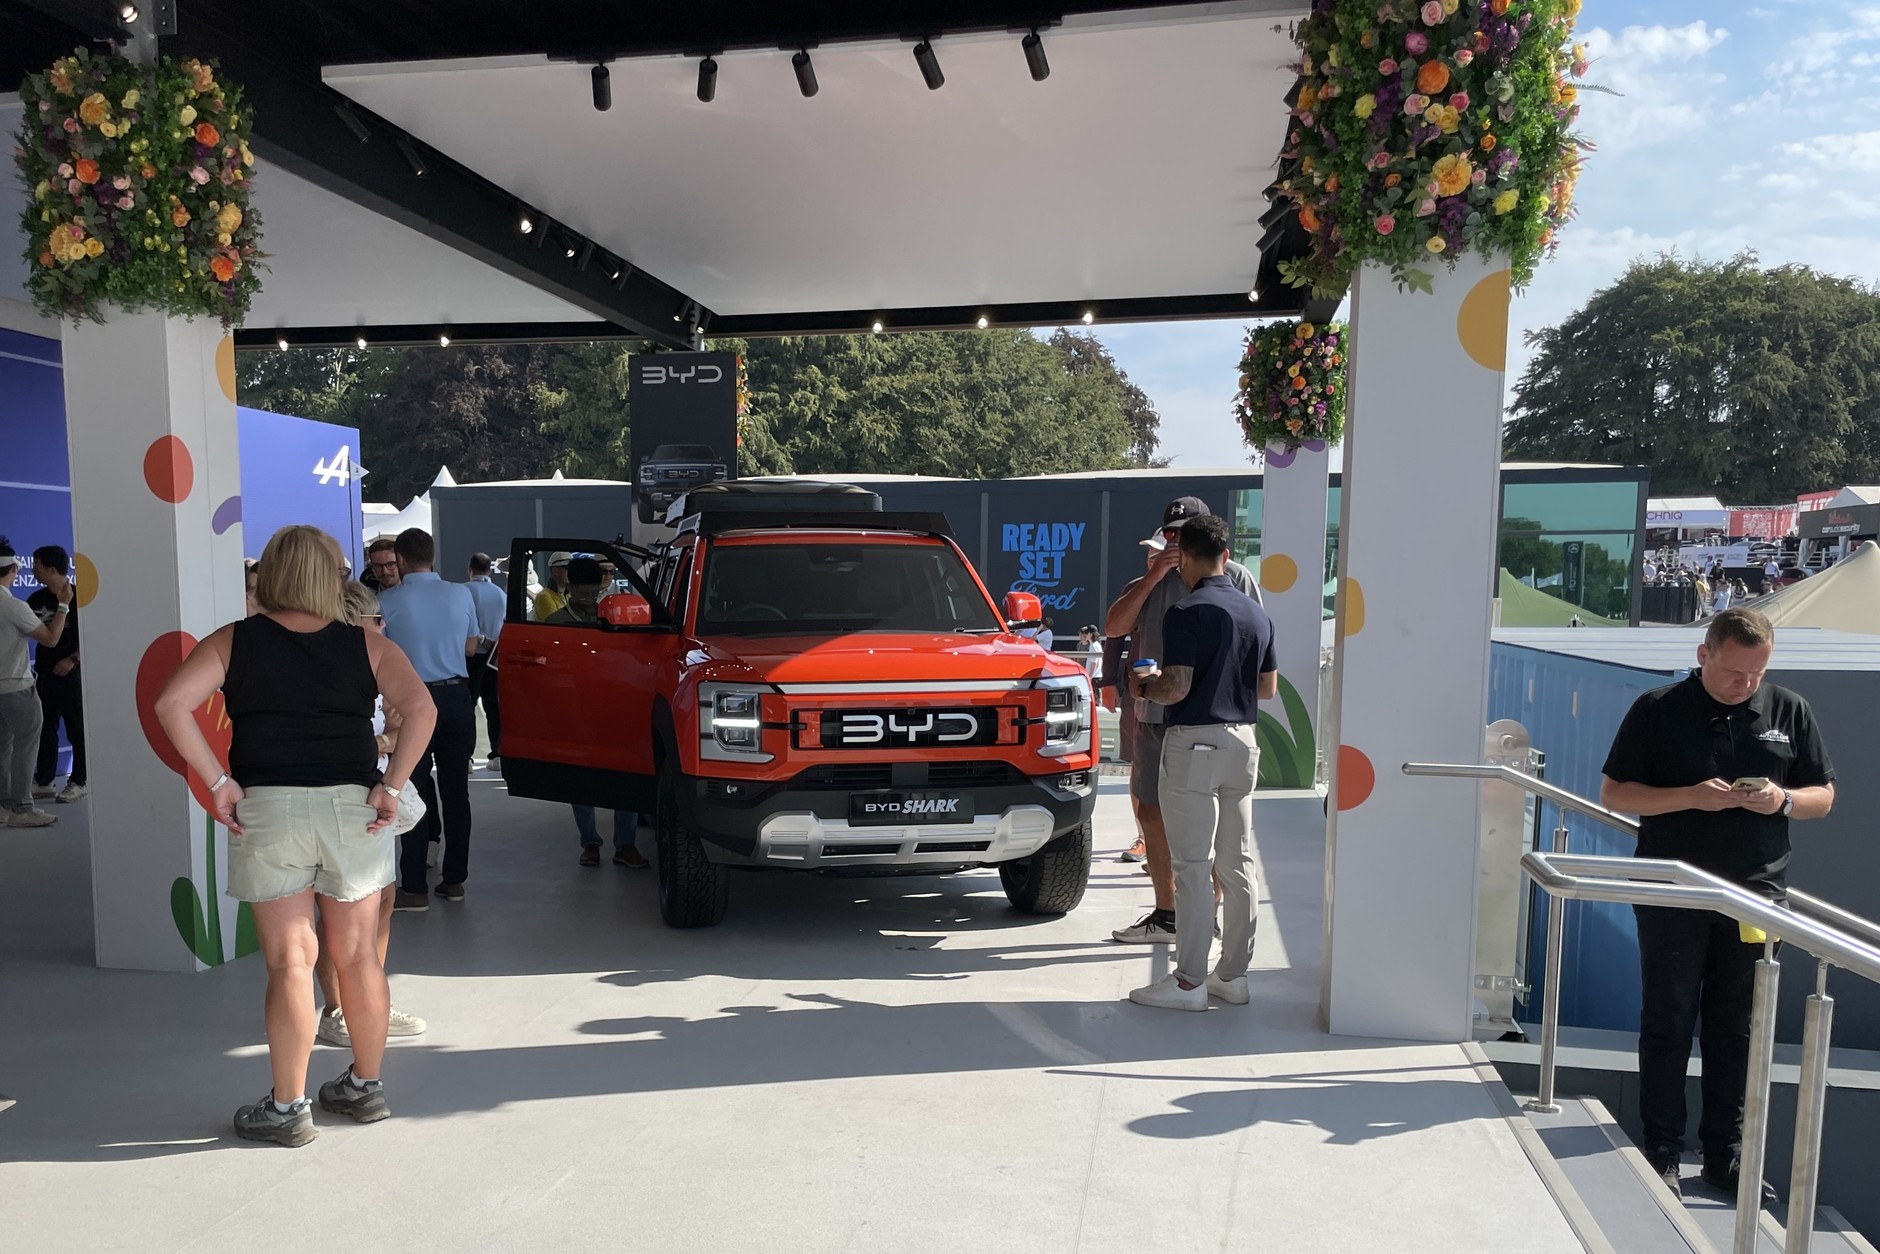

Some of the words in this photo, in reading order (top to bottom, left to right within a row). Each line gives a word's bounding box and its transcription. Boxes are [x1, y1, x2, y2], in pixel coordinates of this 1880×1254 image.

[642, 365, 723, 384] BYD
[668, 470, 700, 479] BYD
[1002, 523, 1086, 551] READY
[1019, 551, 1066, 579] SET
[842, 713, 978, 743] BYD
[865, 803, 900, 812] BYD
[902, 799, 960, 814] SHARK
